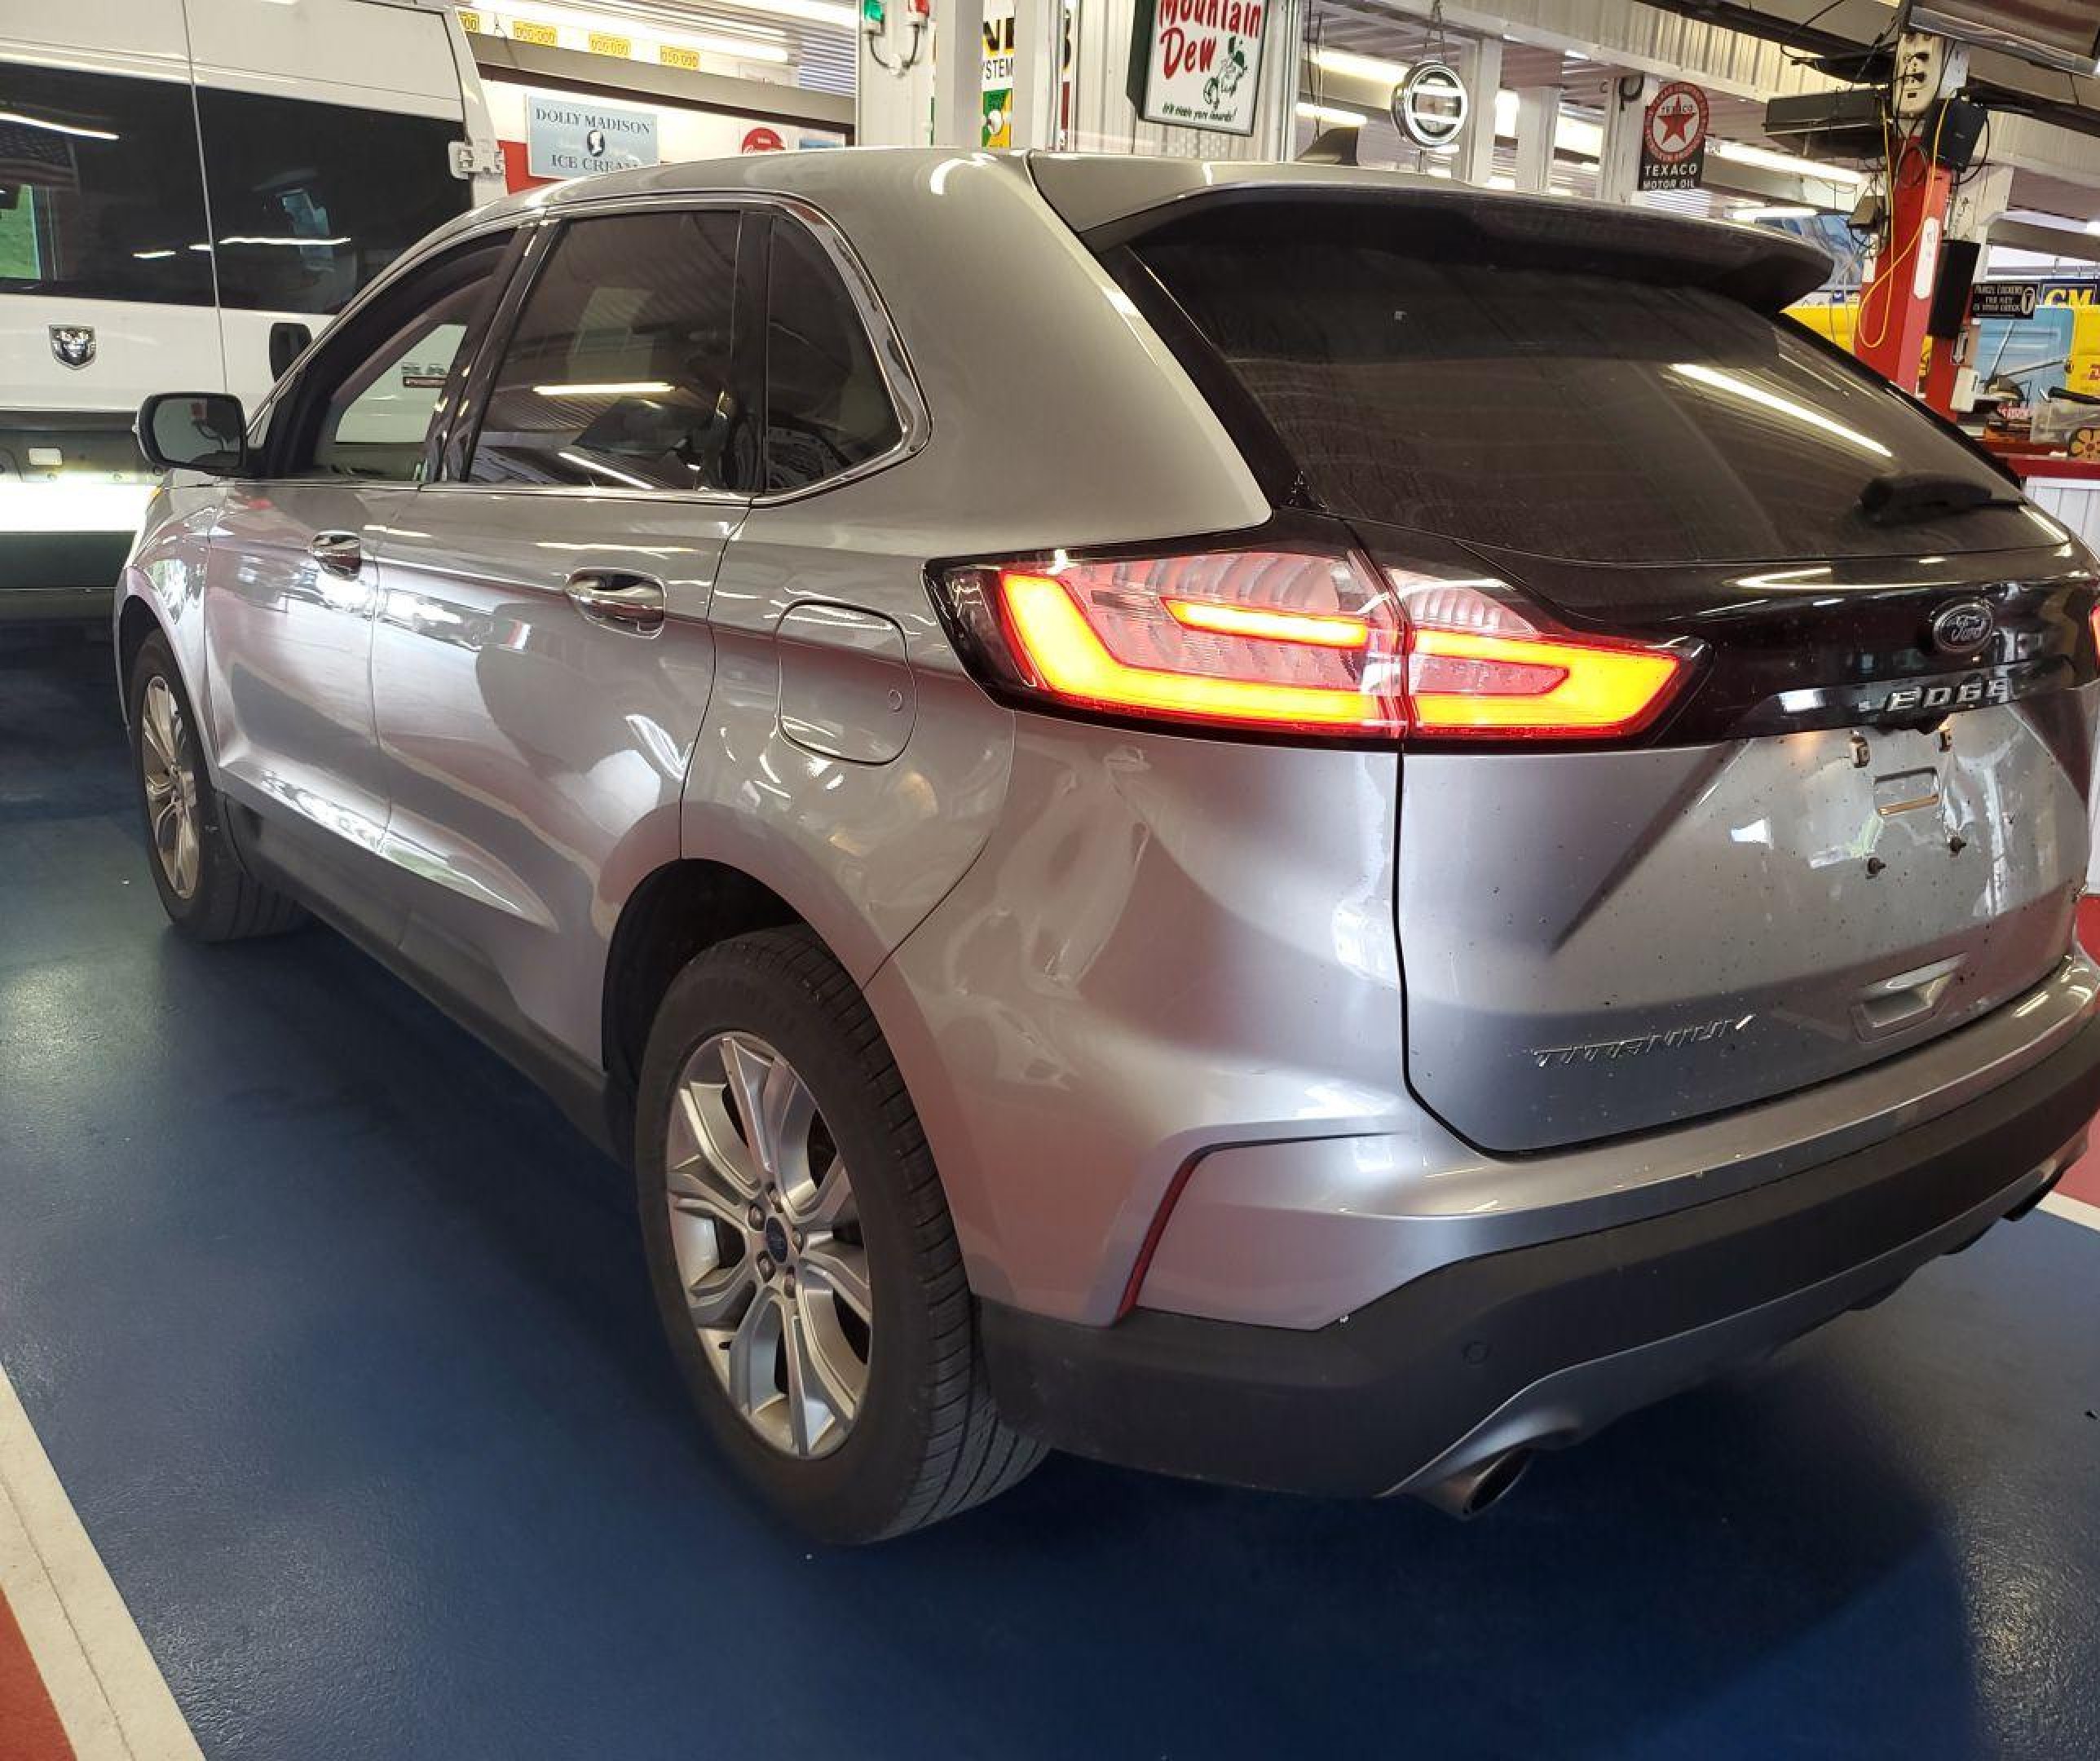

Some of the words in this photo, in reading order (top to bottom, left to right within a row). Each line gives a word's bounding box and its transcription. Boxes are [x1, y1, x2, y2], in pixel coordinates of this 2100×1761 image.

[1159, 27, 1216, 79] Dew
[536, 108, 581, 125] DOLLY
[585, 115, 651, 134] MADISON
[552, 154, 578, 169] ICE
[1643, 164, 1697, 177] TEXACO
[1643, 179, 1677, 190] MOTOR
[1680, 179, 1695, 188] OIL
[1946, 615, 1983, 642] Ford
[1886, 678, 2012, 712] EDGE
[1531, 1013, 1755, 1067] TITANIUM
